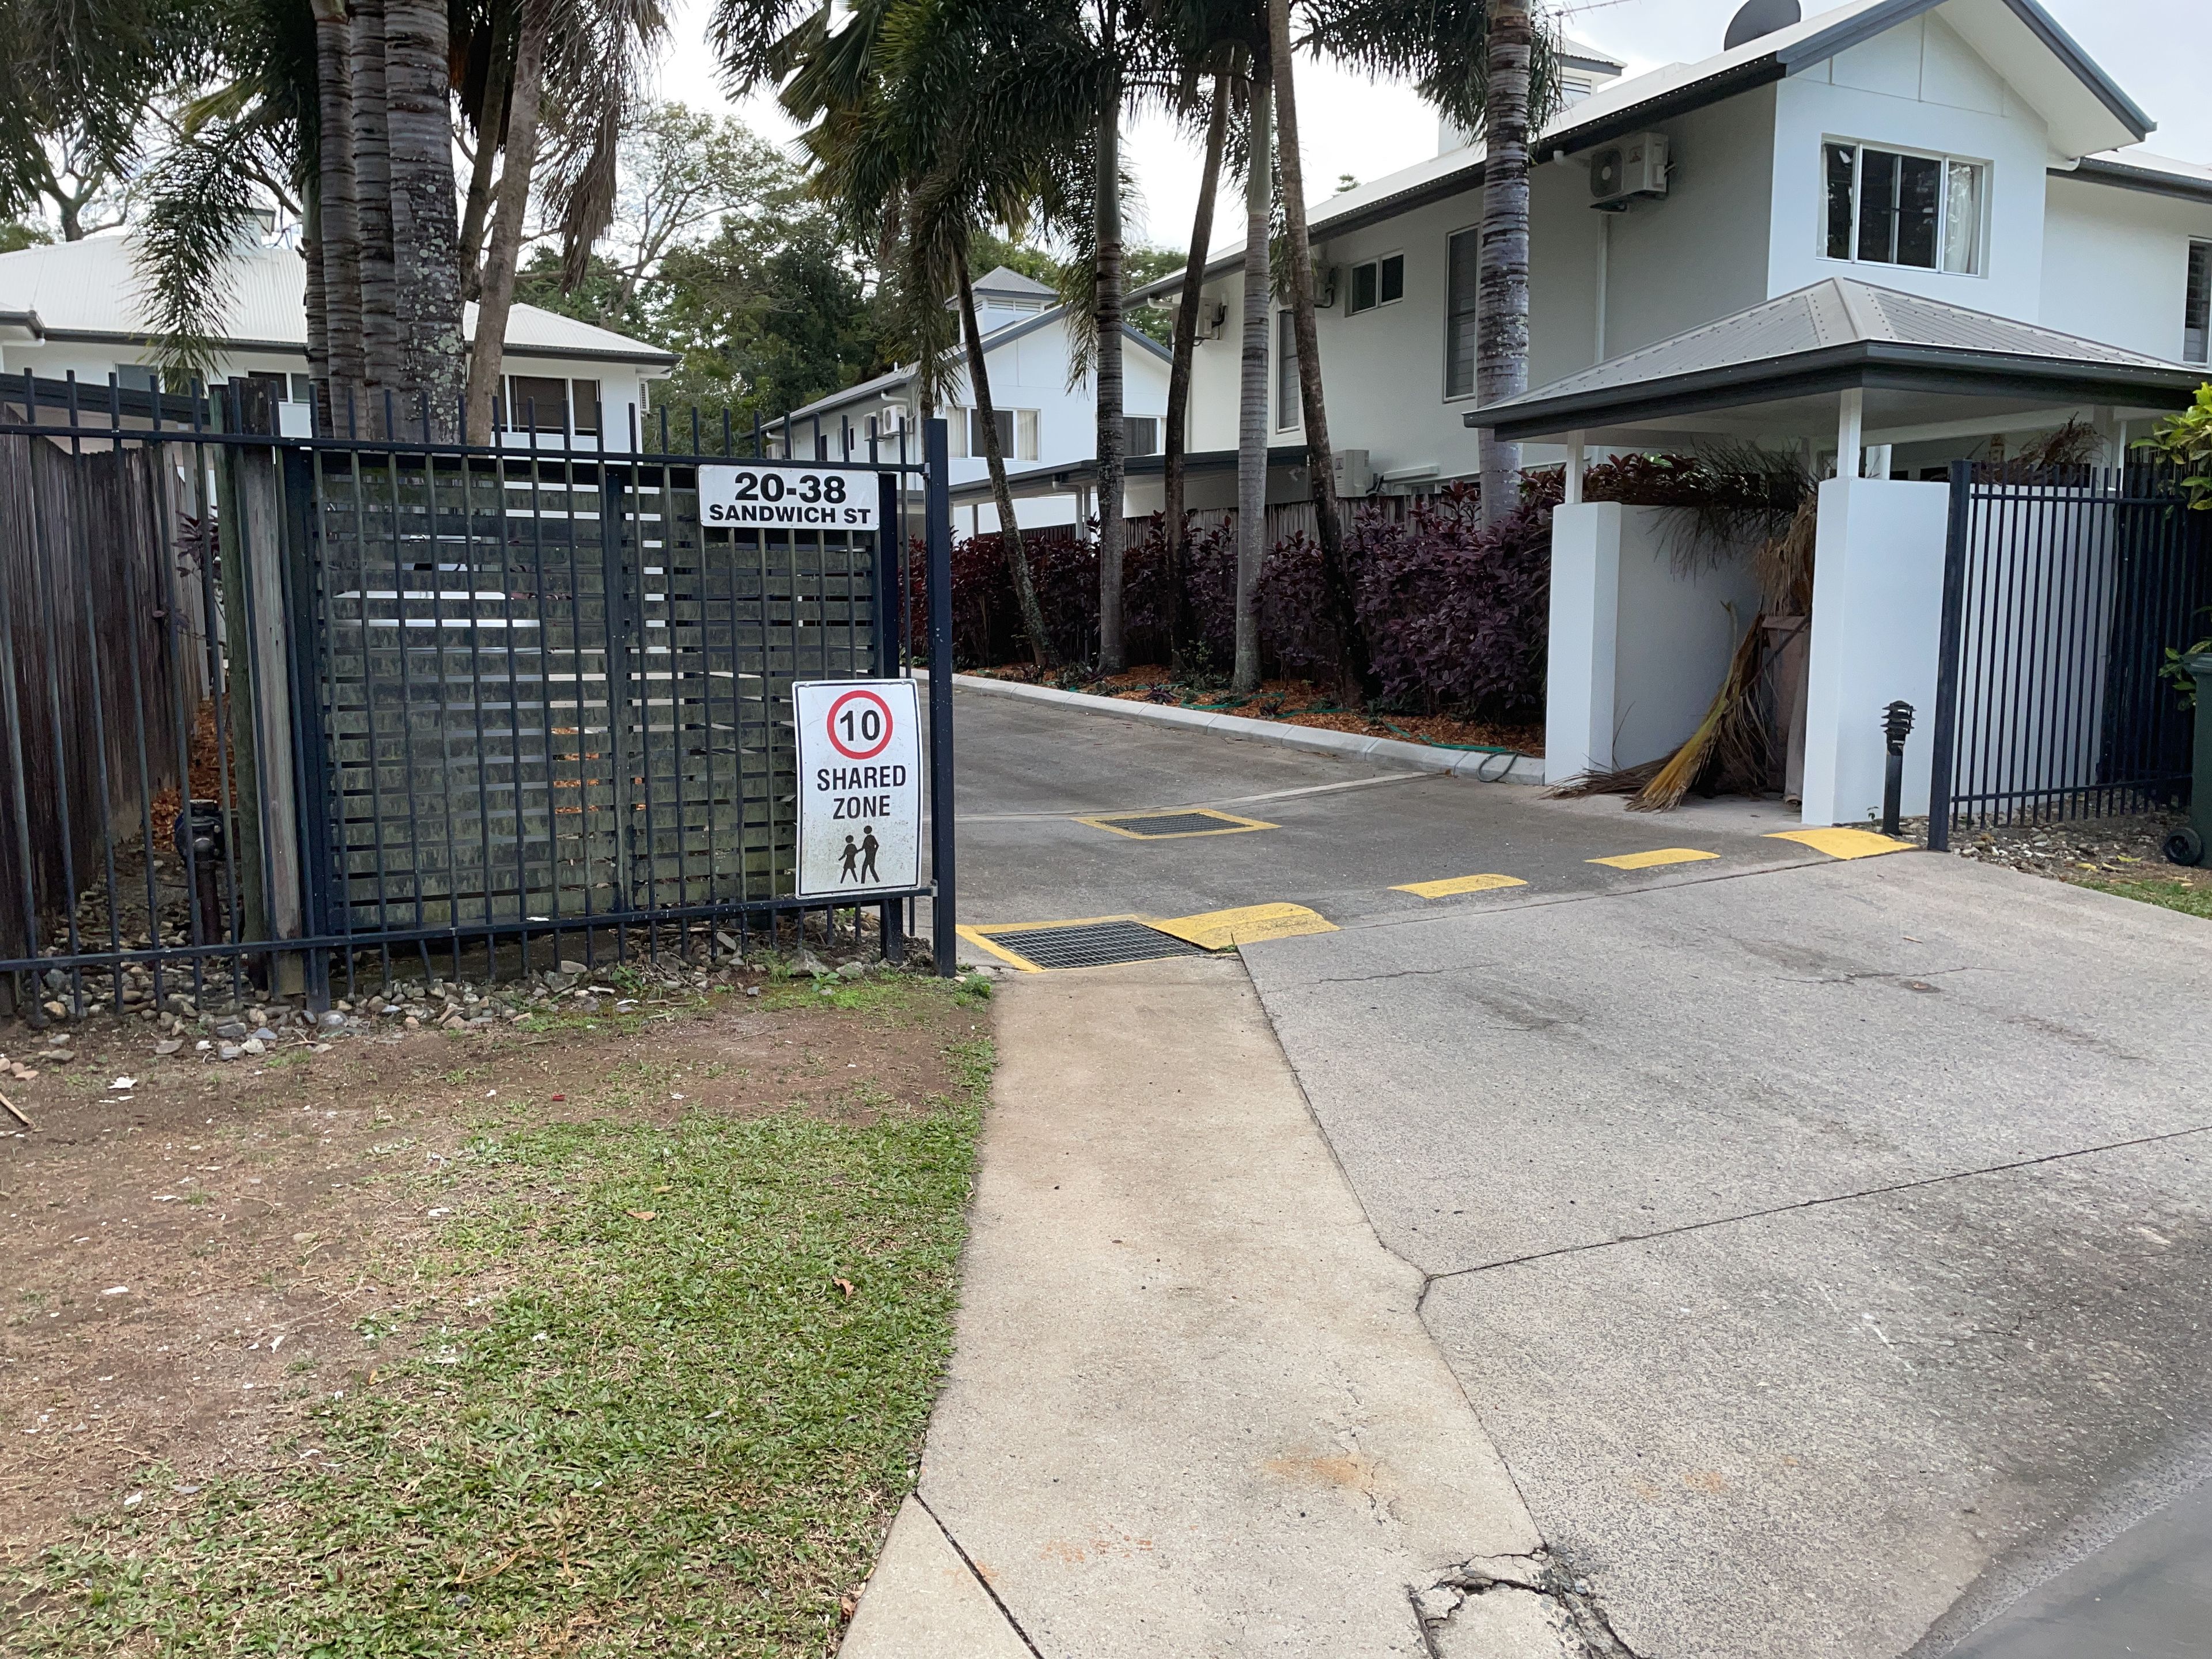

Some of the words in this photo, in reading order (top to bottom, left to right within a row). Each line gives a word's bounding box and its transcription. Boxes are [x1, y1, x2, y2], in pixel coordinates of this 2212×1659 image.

[734, 472, 846, 504] 20-38
[709, 504, 836, 523] SANDWICH
[843, 508, 871, 524] ST
[840, 710, 880, 741] 10
[817, 765, 906, 791] SHARED
[833, 795, 891, 820] ZONE
